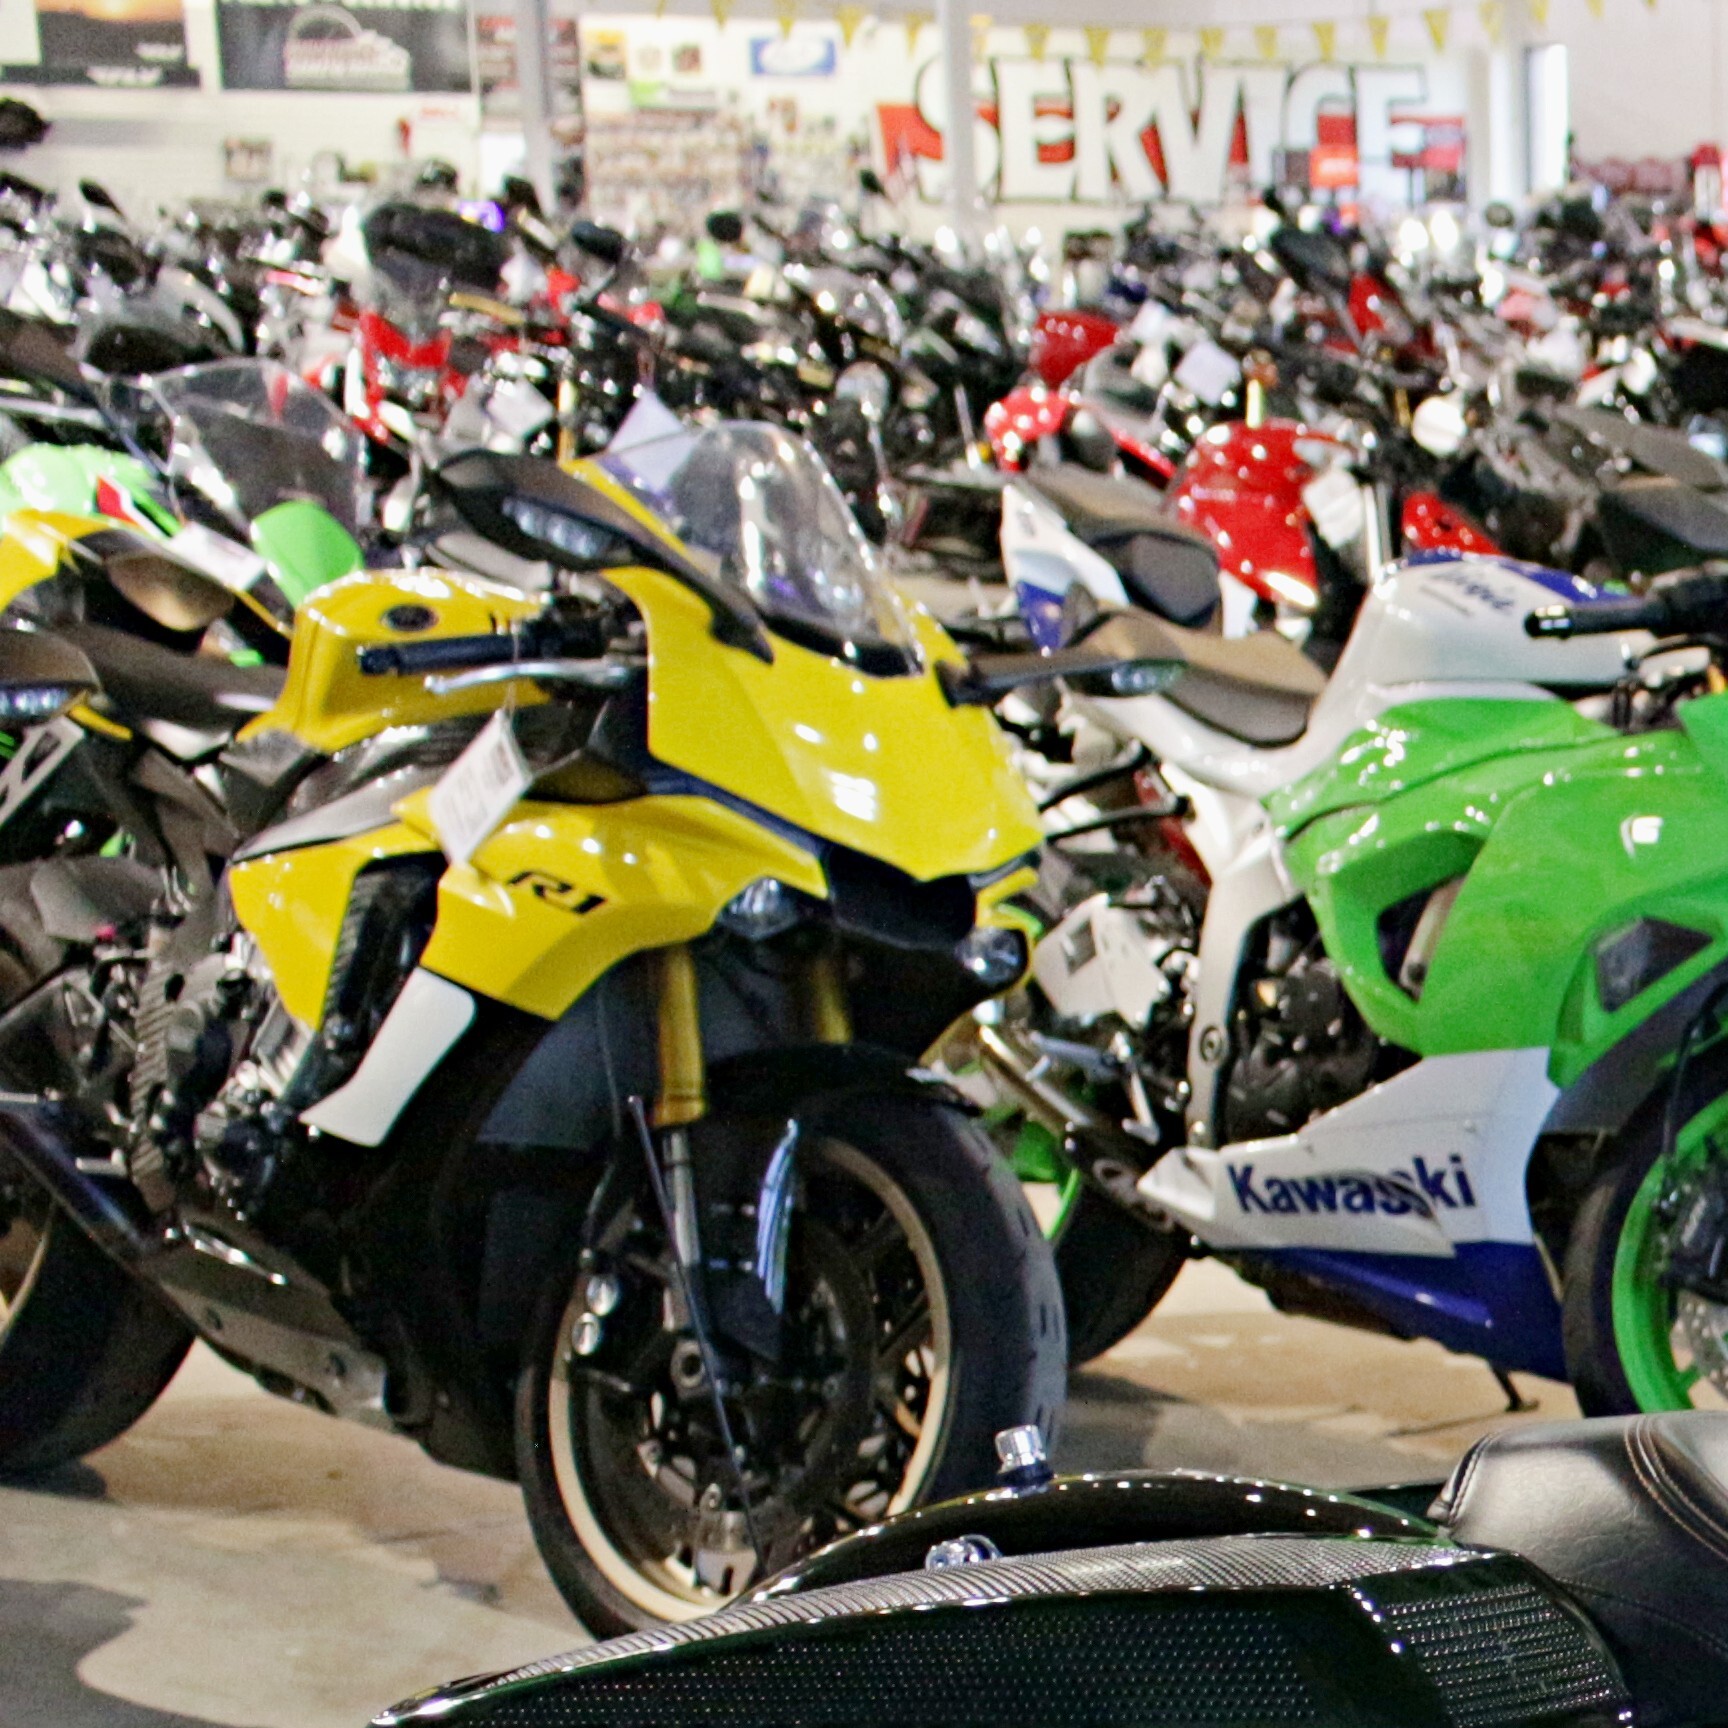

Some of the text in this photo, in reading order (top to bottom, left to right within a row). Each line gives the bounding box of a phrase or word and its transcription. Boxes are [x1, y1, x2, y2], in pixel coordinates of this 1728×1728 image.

[914, 52, 1427, 204] SERVICE
[506, 868, 605, 915] R1
[1227, 1153, 1477, 1217] Kawasaki
